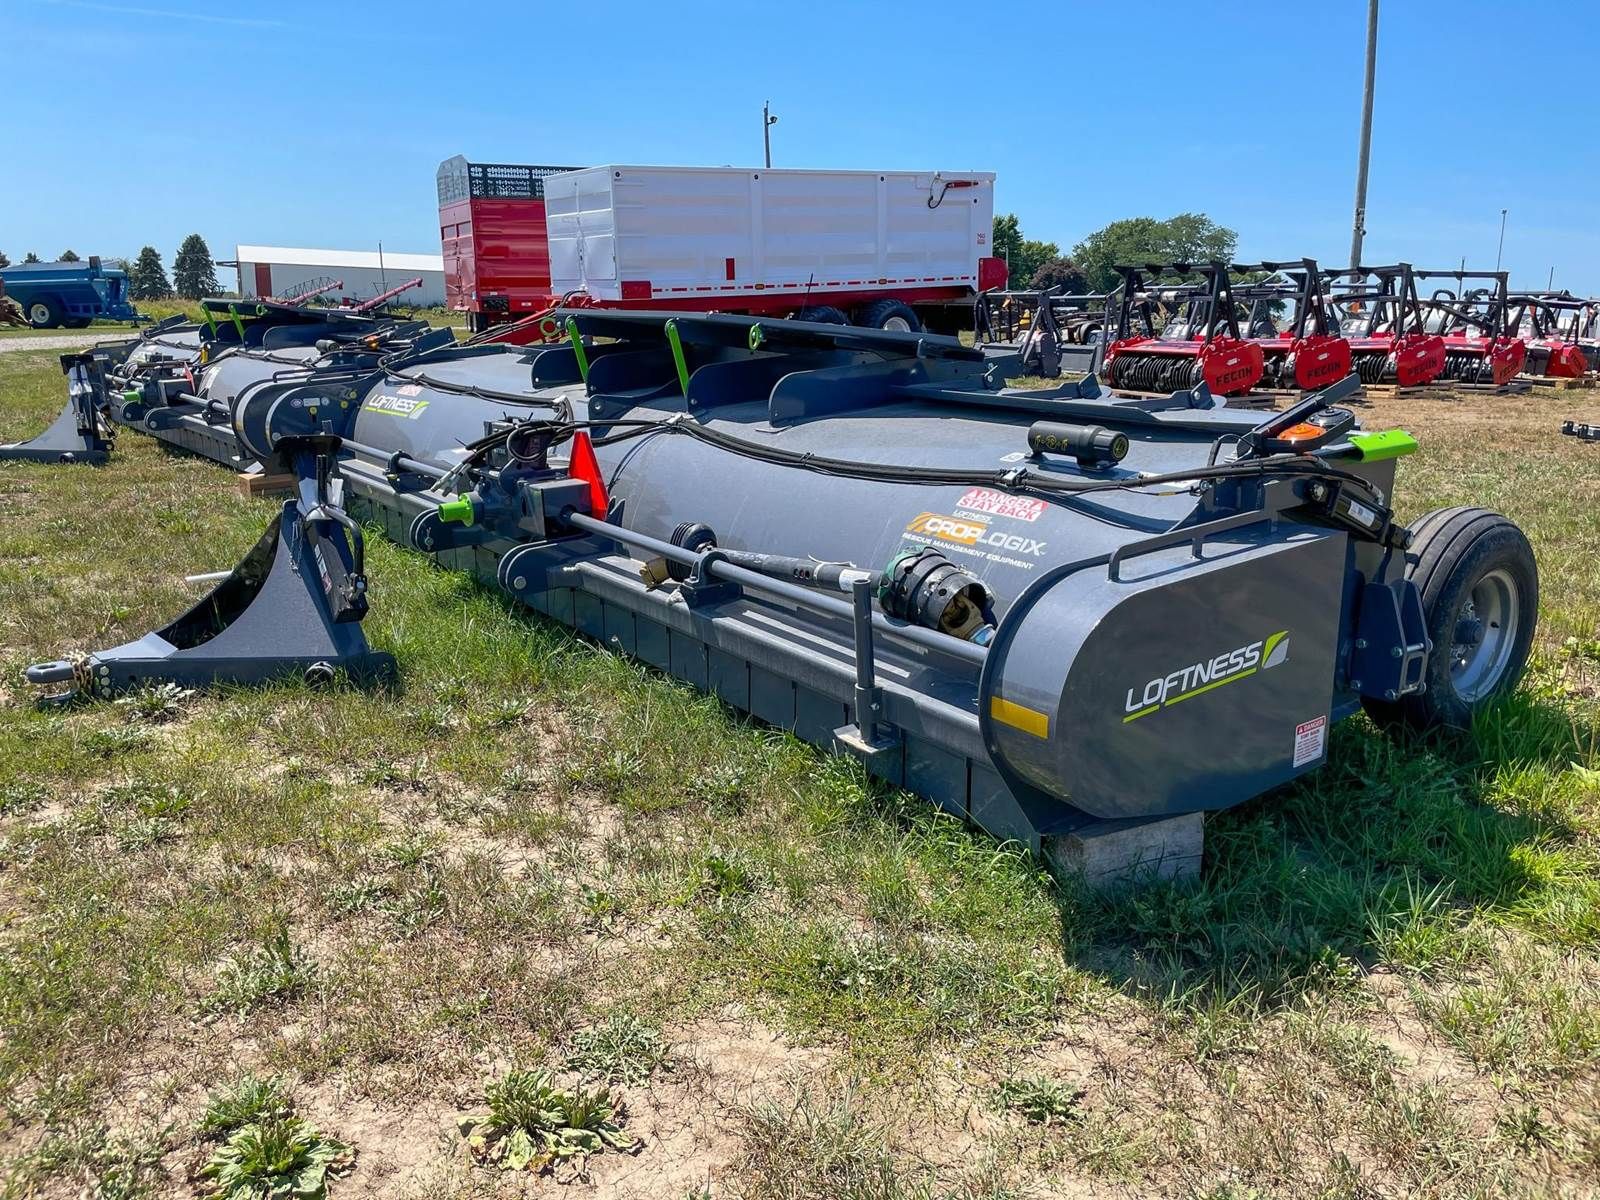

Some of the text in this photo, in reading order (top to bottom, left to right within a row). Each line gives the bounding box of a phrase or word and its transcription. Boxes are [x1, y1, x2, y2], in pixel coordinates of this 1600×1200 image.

[1216, 366, 1252, 387] FECON
[368, 394, 419, 413] LOFTNESS
[960, 497, 1037, 520] STAY BACK
[978, 490, 1033, 509] DANGER
[933, 538, 985, 558] MANAGEMENT
[986, 553, 1034, 569] EQUIPMENT
[1125, 640, 1263, 712] LOFTNESS
